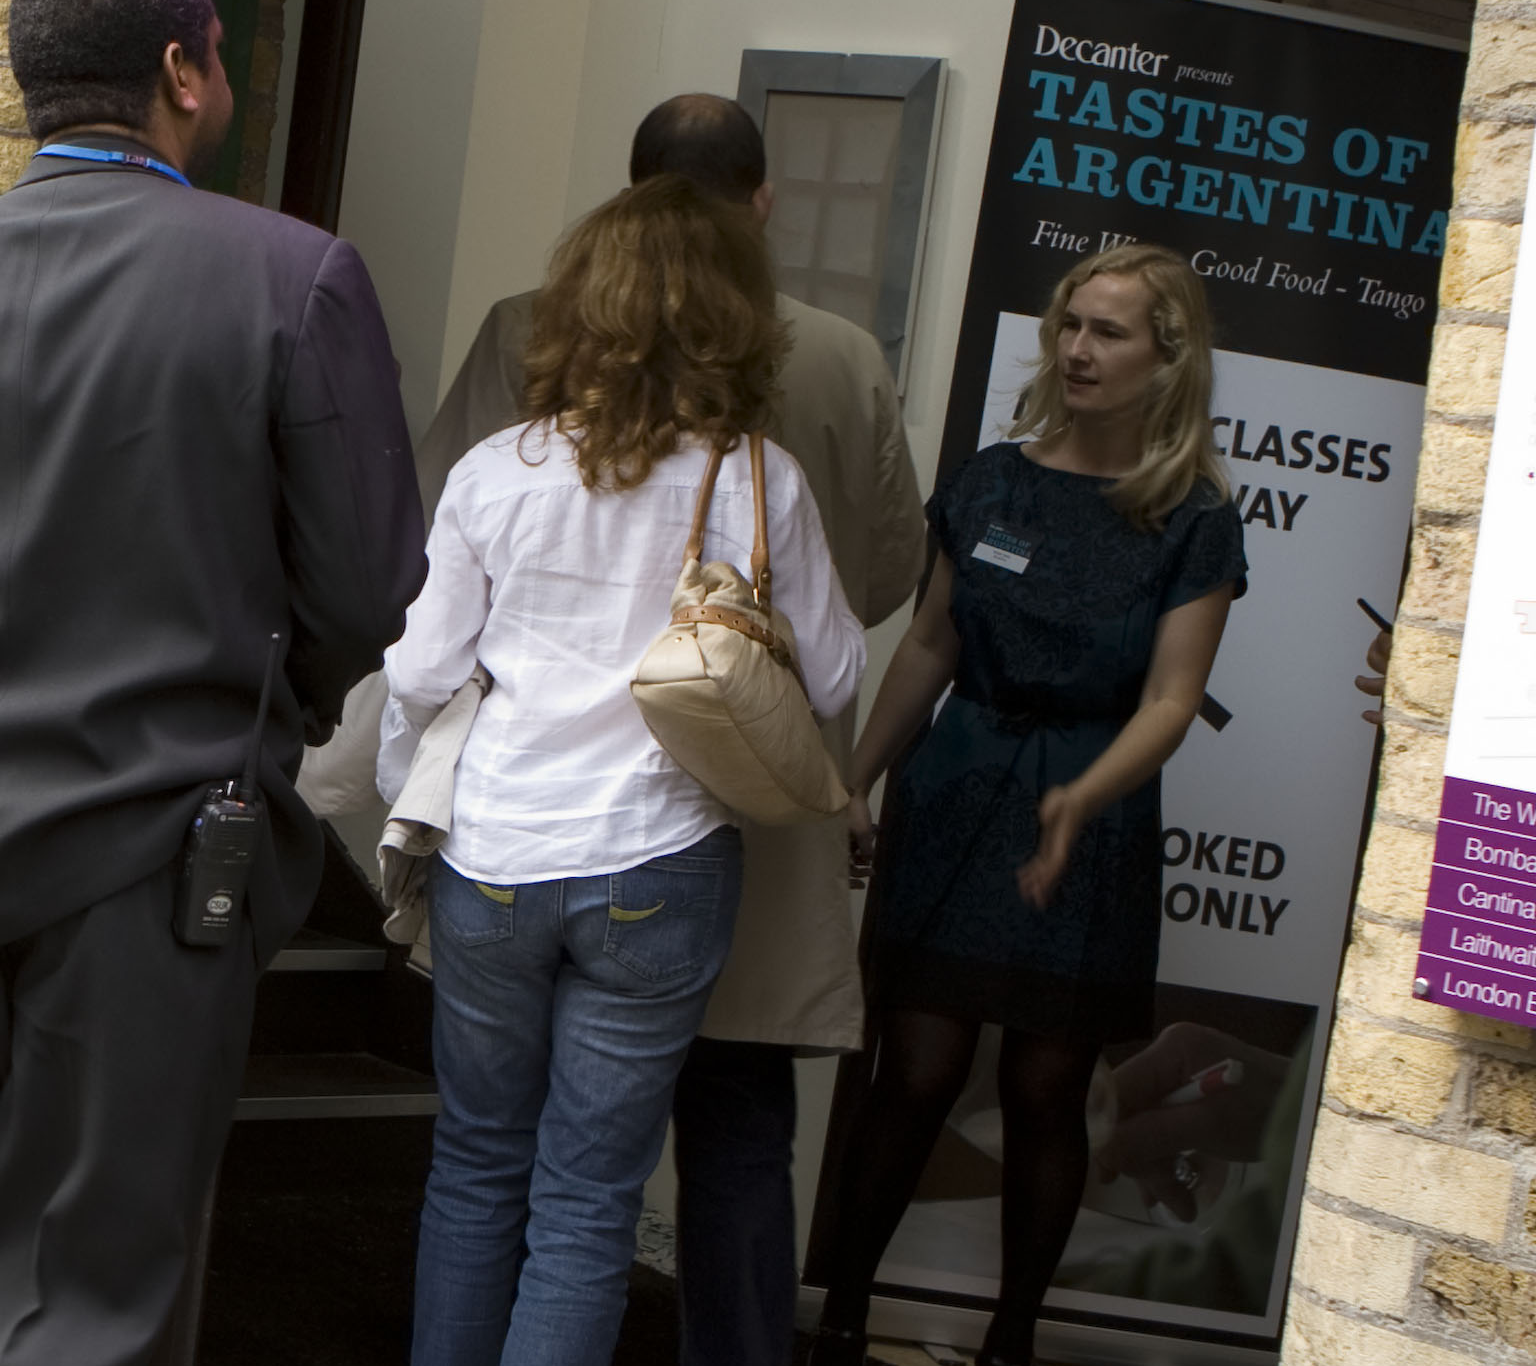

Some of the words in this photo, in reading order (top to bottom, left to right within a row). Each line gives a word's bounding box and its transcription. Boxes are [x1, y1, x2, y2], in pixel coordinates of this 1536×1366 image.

[1033, 24, 1169, 78] Decanter
[1174, 63, 1234, 87] presents
[1029, 69, 1308, 166] TASTES
[1332, 127, 1429, 186] OF
[1013, 137, 1450, 258] ARGENTINA
[1031, 220, 1089, 254] Fine
[1190, 249, 1264, 286] Good
[1265, 262, 1332, 297] Food
[1357, 277, 1426, 320] Tango
[1472, 792, 1512, 822] The
[1164, 883, 1291, 936] ONLY
[1458, 882, 1536, 921] Cantina
[1443, 972, 1522, 1011] London
